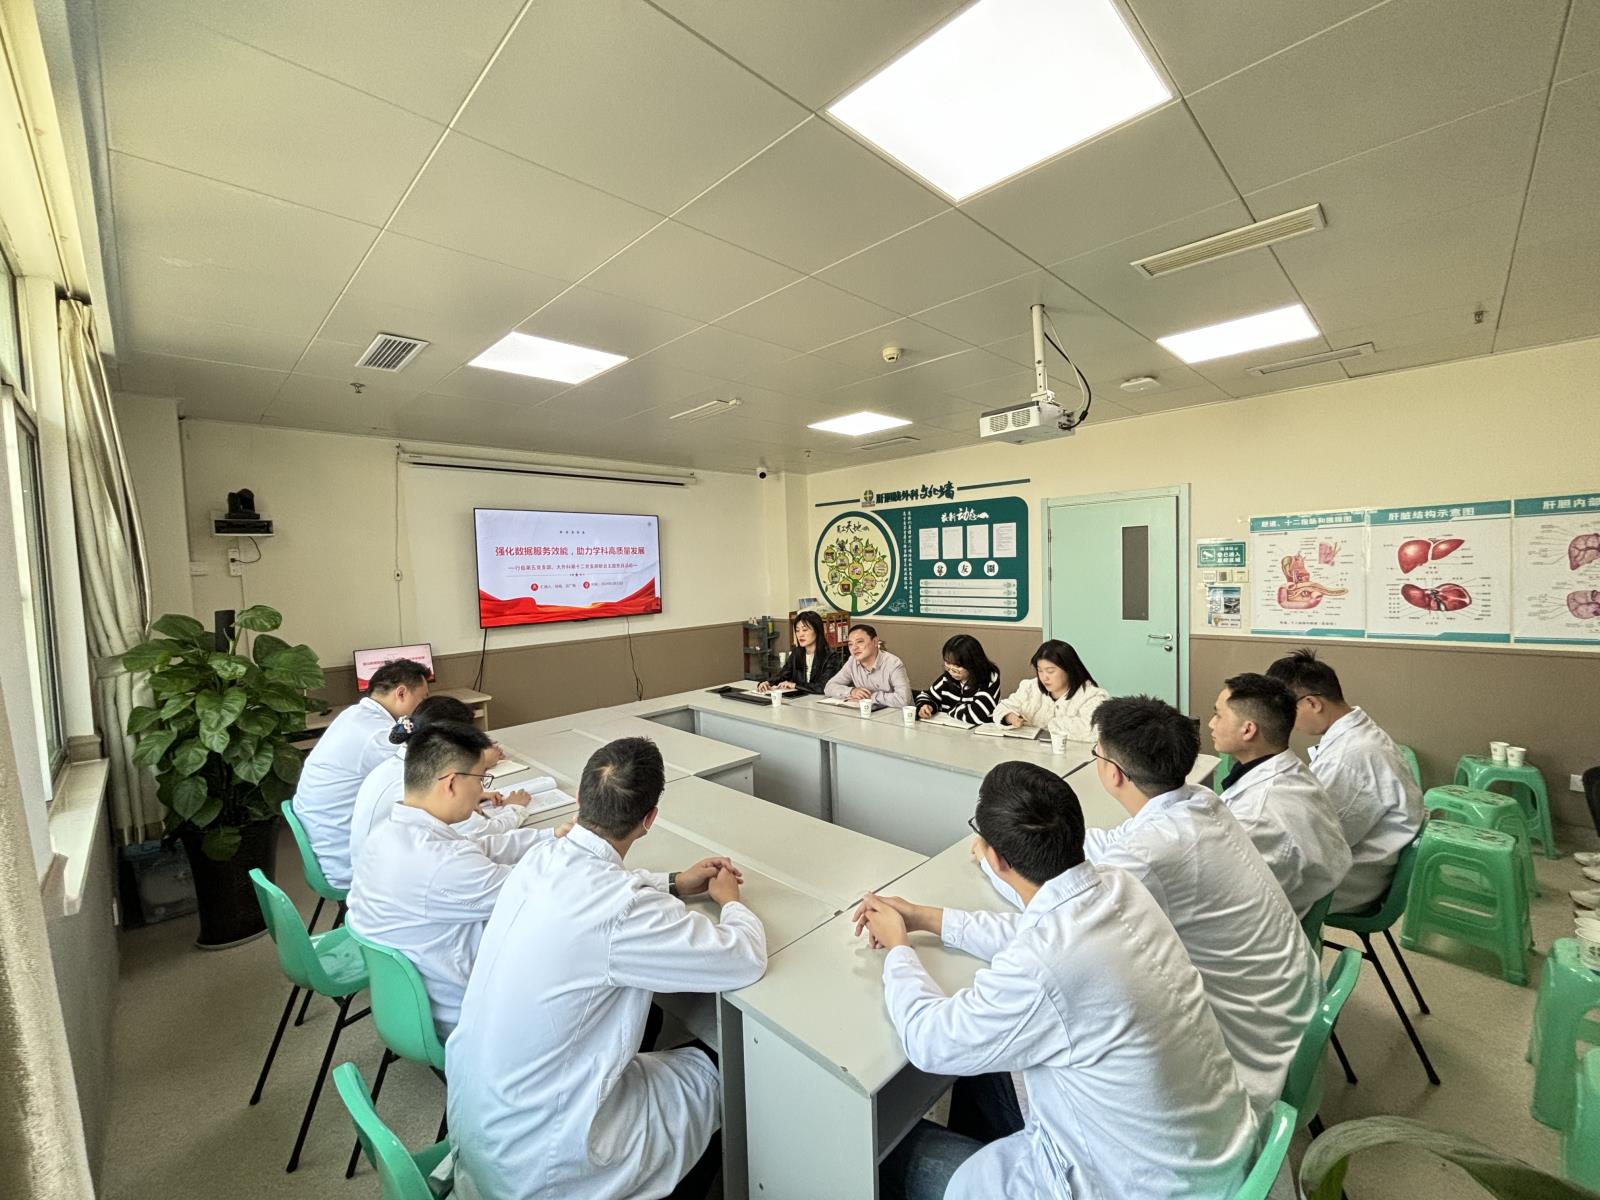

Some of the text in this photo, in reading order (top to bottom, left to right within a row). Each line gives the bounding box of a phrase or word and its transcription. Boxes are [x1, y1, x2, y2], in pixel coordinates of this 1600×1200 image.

[1388, 507, 1475, 521] 肝脏结构示意图
